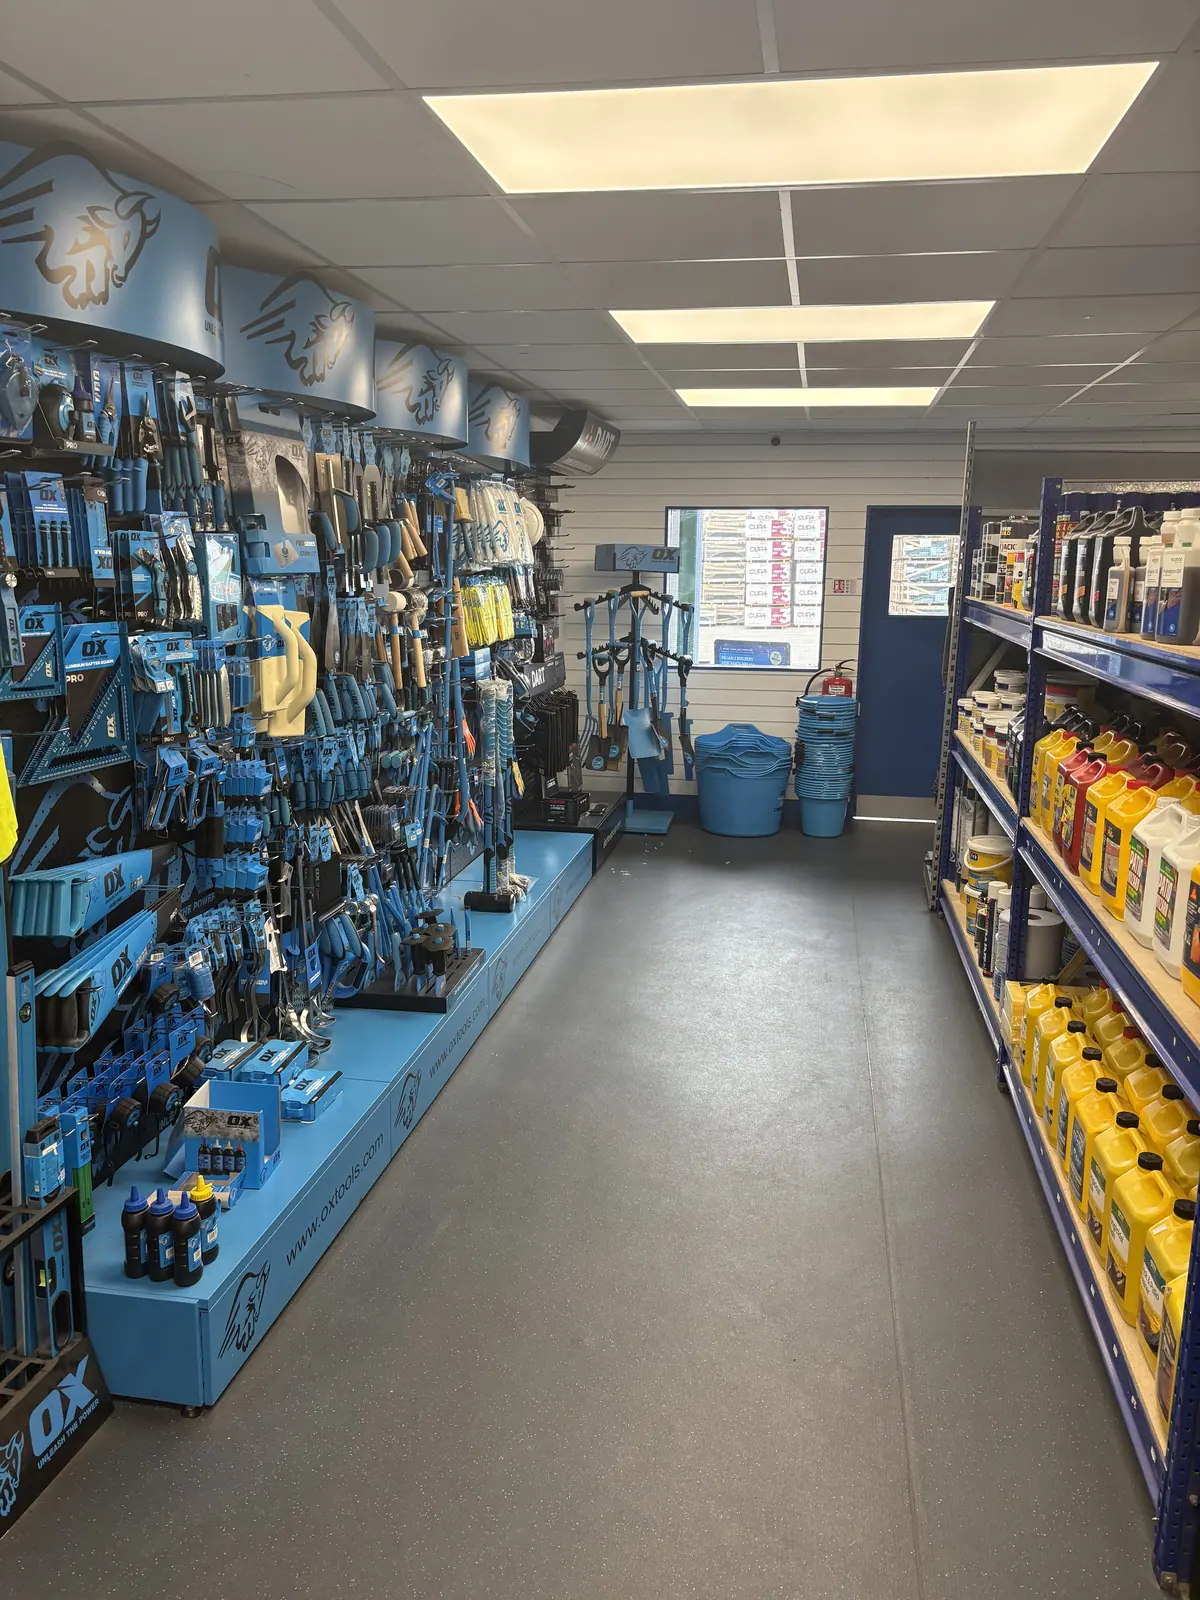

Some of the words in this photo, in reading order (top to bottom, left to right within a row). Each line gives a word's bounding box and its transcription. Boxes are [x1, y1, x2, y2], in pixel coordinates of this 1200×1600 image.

[66, 442, 78, 450] PRO
[40, 490, 57, 502] OX
[131, 533, 141, 541] OX
[652, 548, 677, 561] OX
[24, 617, 45, 631] OX
[82, 639, 108, 657] OX
[166, 642, 180, 652] OX
[66, 674, 84, 683] PRO
[532, 667, 546, 688] DART
[107, 714, 116, 738] OX
[323, 748, 332, 756] OX
[103, 863, 125, 898] OX
[111, 944, 132, 989] OX
[429, 998, 485, 1078] www.oxtools.com
[259, 1049, 278, 1062] OX
[294, 1078, 313, 1090] OX
[227, 1115, 252, 1127] OX
[286, 1133, 384, 1266] www.oxtools.com
[53, 1220, 63, 1253] OX
[29, 1354, 95, 1457] OX
[37, 1435, 66, 1470] UNLEASH
[65, 1423, 79, 1438] THE
[79, 1398, 100, 1425] POWER
